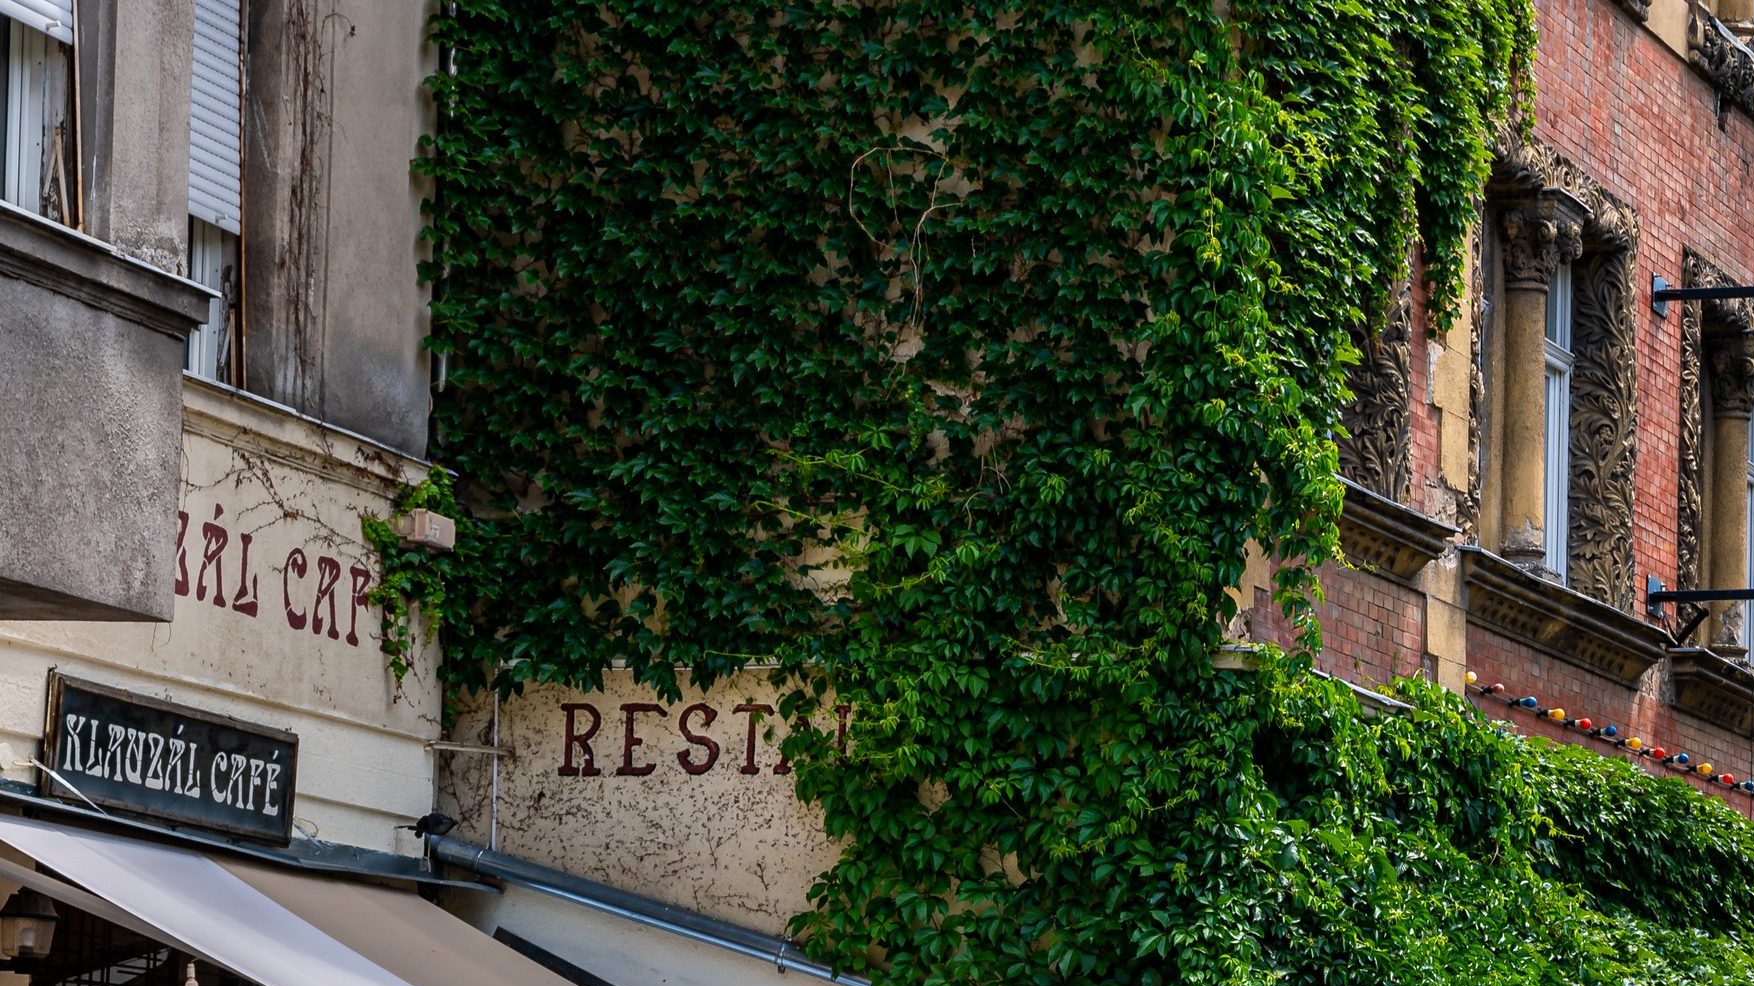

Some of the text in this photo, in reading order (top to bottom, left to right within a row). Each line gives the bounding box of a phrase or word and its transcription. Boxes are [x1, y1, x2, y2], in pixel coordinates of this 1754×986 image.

[283, 547, 388, 653] CAF
[63, 714, 281, 816] KLAUZÁL CAFÉ
